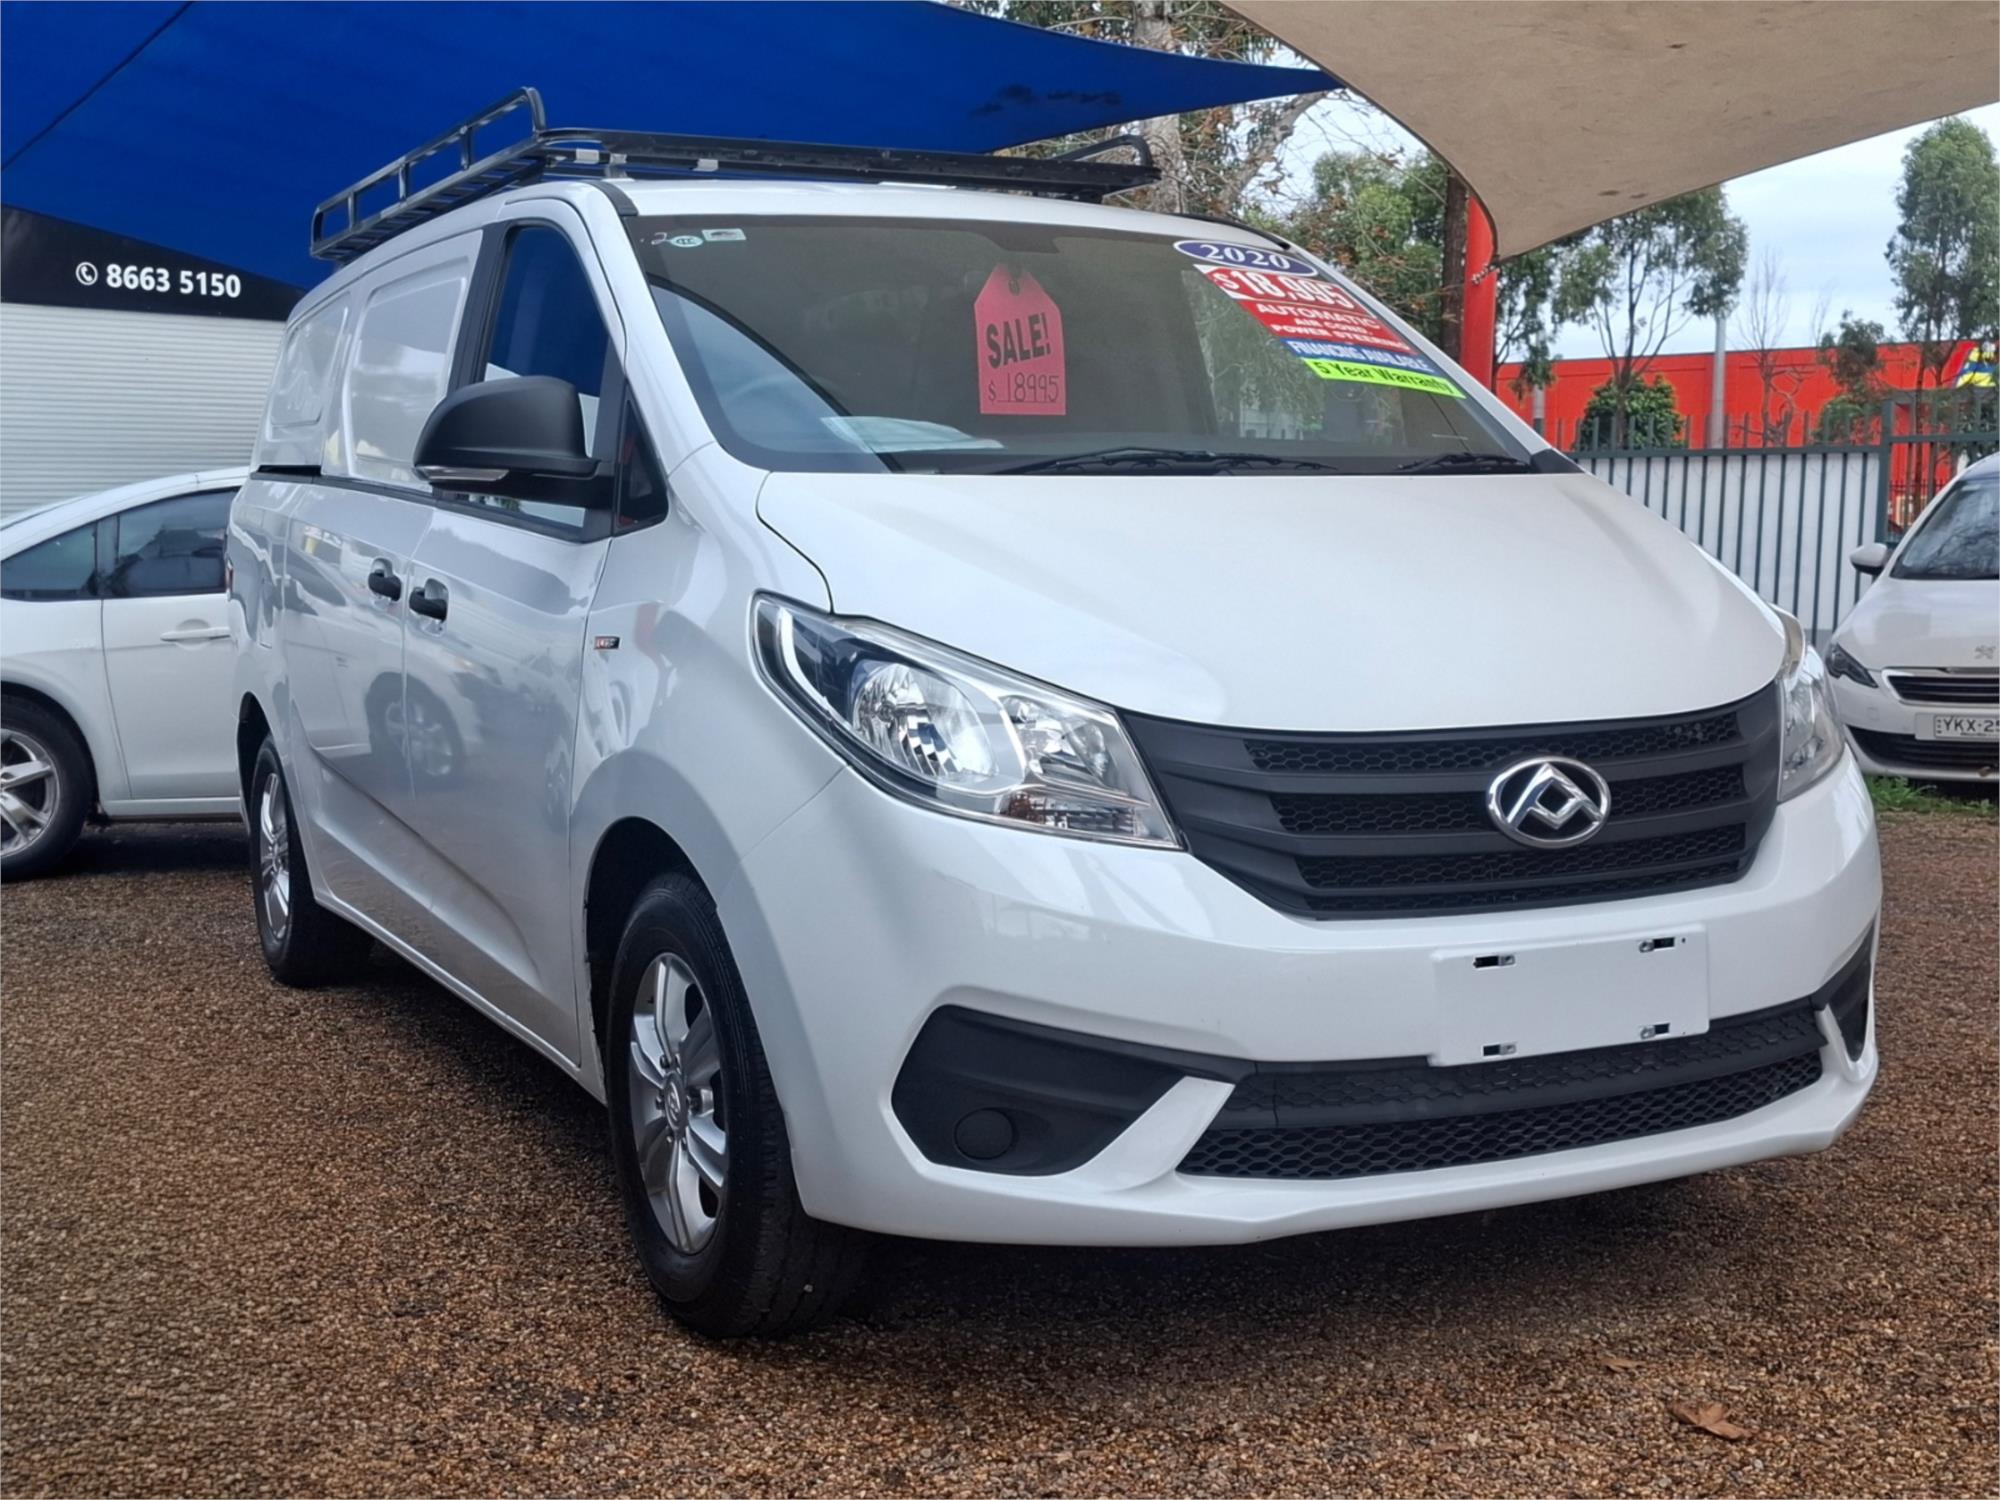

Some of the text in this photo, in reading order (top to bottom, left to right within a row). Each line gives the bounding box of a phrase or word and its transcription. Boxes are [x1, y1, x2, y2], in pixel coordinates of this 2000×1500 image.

[1200, 243, 1291, 270] 2020
[106, 263, 242, 298] 8663 5150
[1213, 269, 1355, 310] $18,995
[1256, 303, 1381, 330] AUTOMATIC
[985, 312, 1052, 369] SALE!
[1006, 371, 1060, 404] 18995
[1313, 360, 1457, 395] 5 Year Warranty
